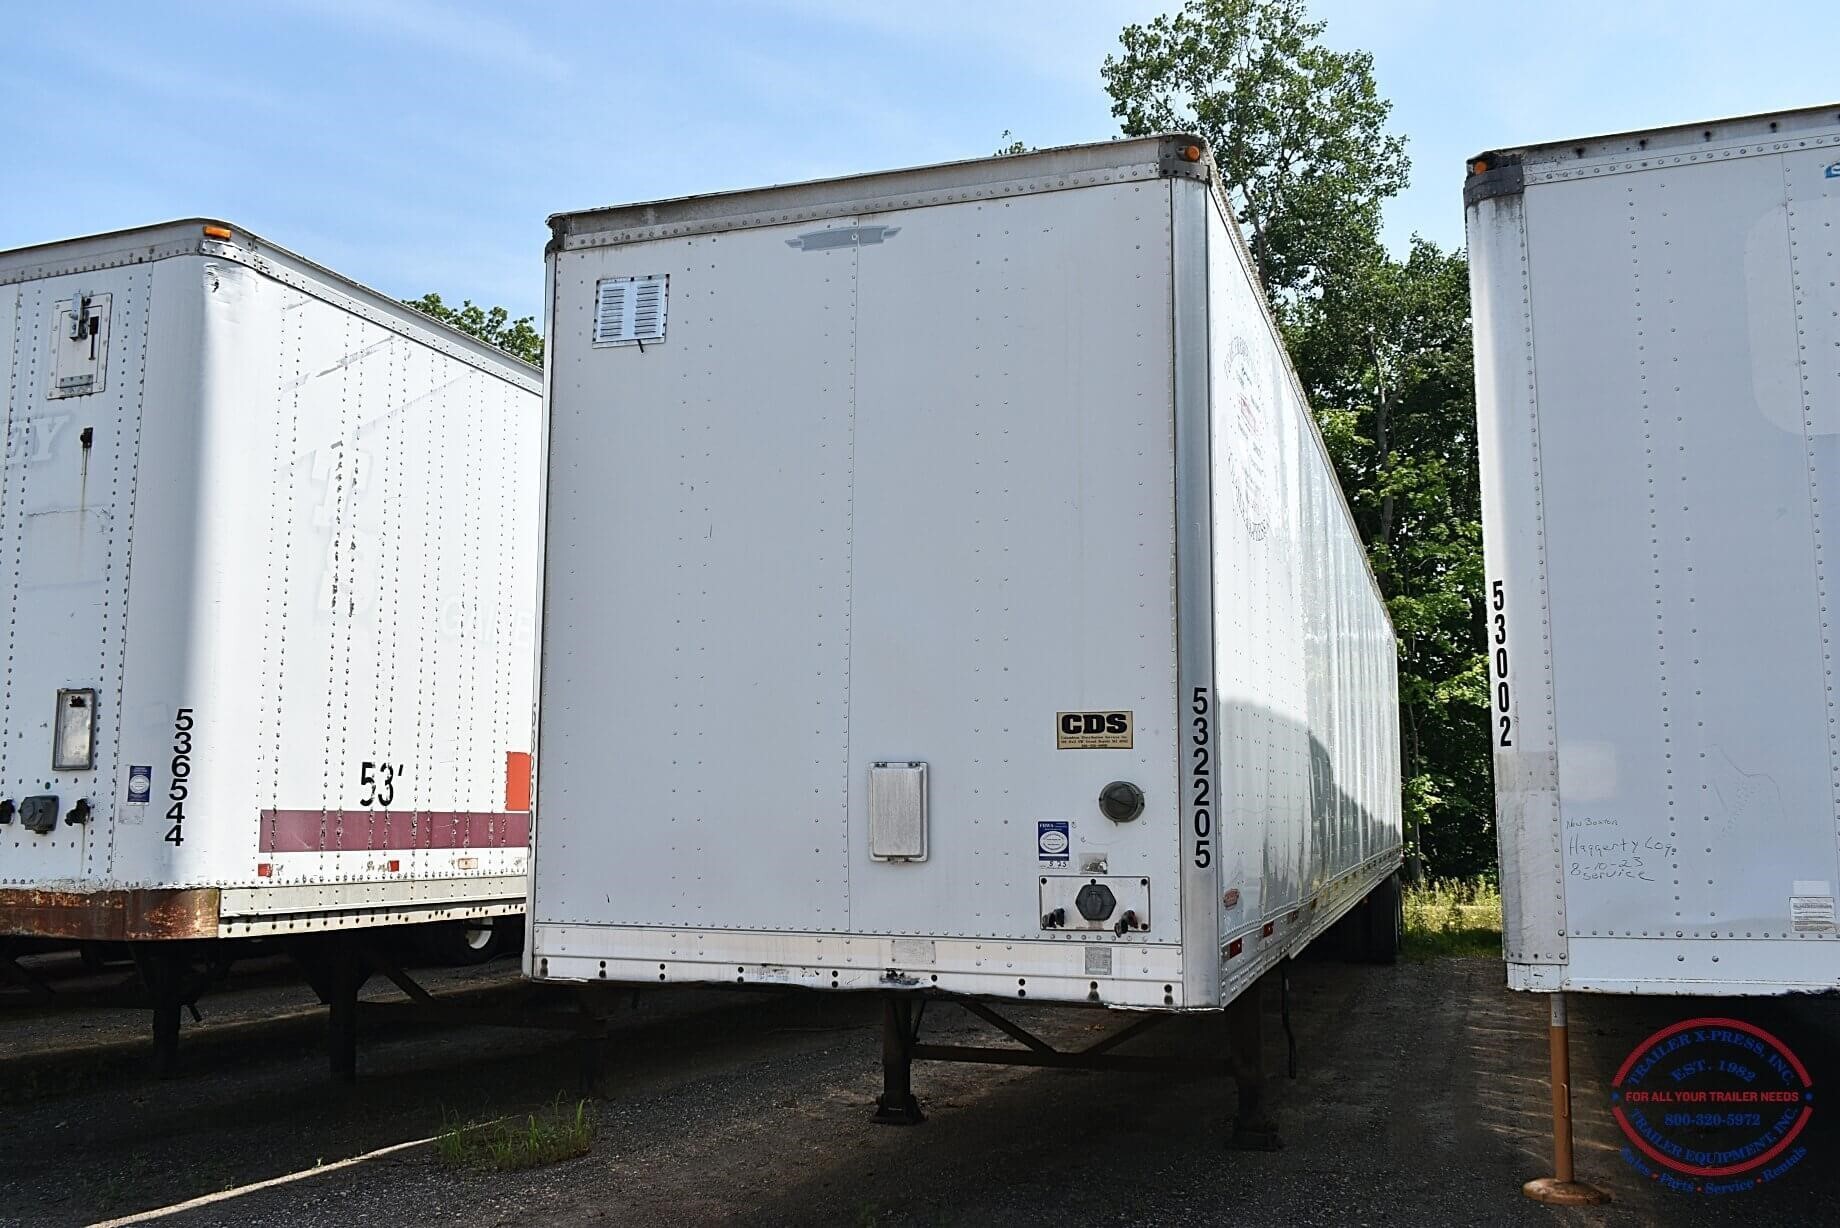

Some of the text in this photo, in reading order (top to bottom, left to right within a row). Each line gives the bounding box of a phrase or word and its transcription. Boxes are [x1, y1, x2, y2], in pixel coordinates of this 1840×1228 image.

[1493, 581, 1511, 746] 53002
[1062, 714, 1127, 734] CDS
[165, 709, 193, 846] 536544
[360, 762, 403, 806] 53'
[1193, 687, 1210, 868] 532205
[1569, 833, 1638, 857] Haggerty
[1570, 857, 1643, 876] 8-10-23
